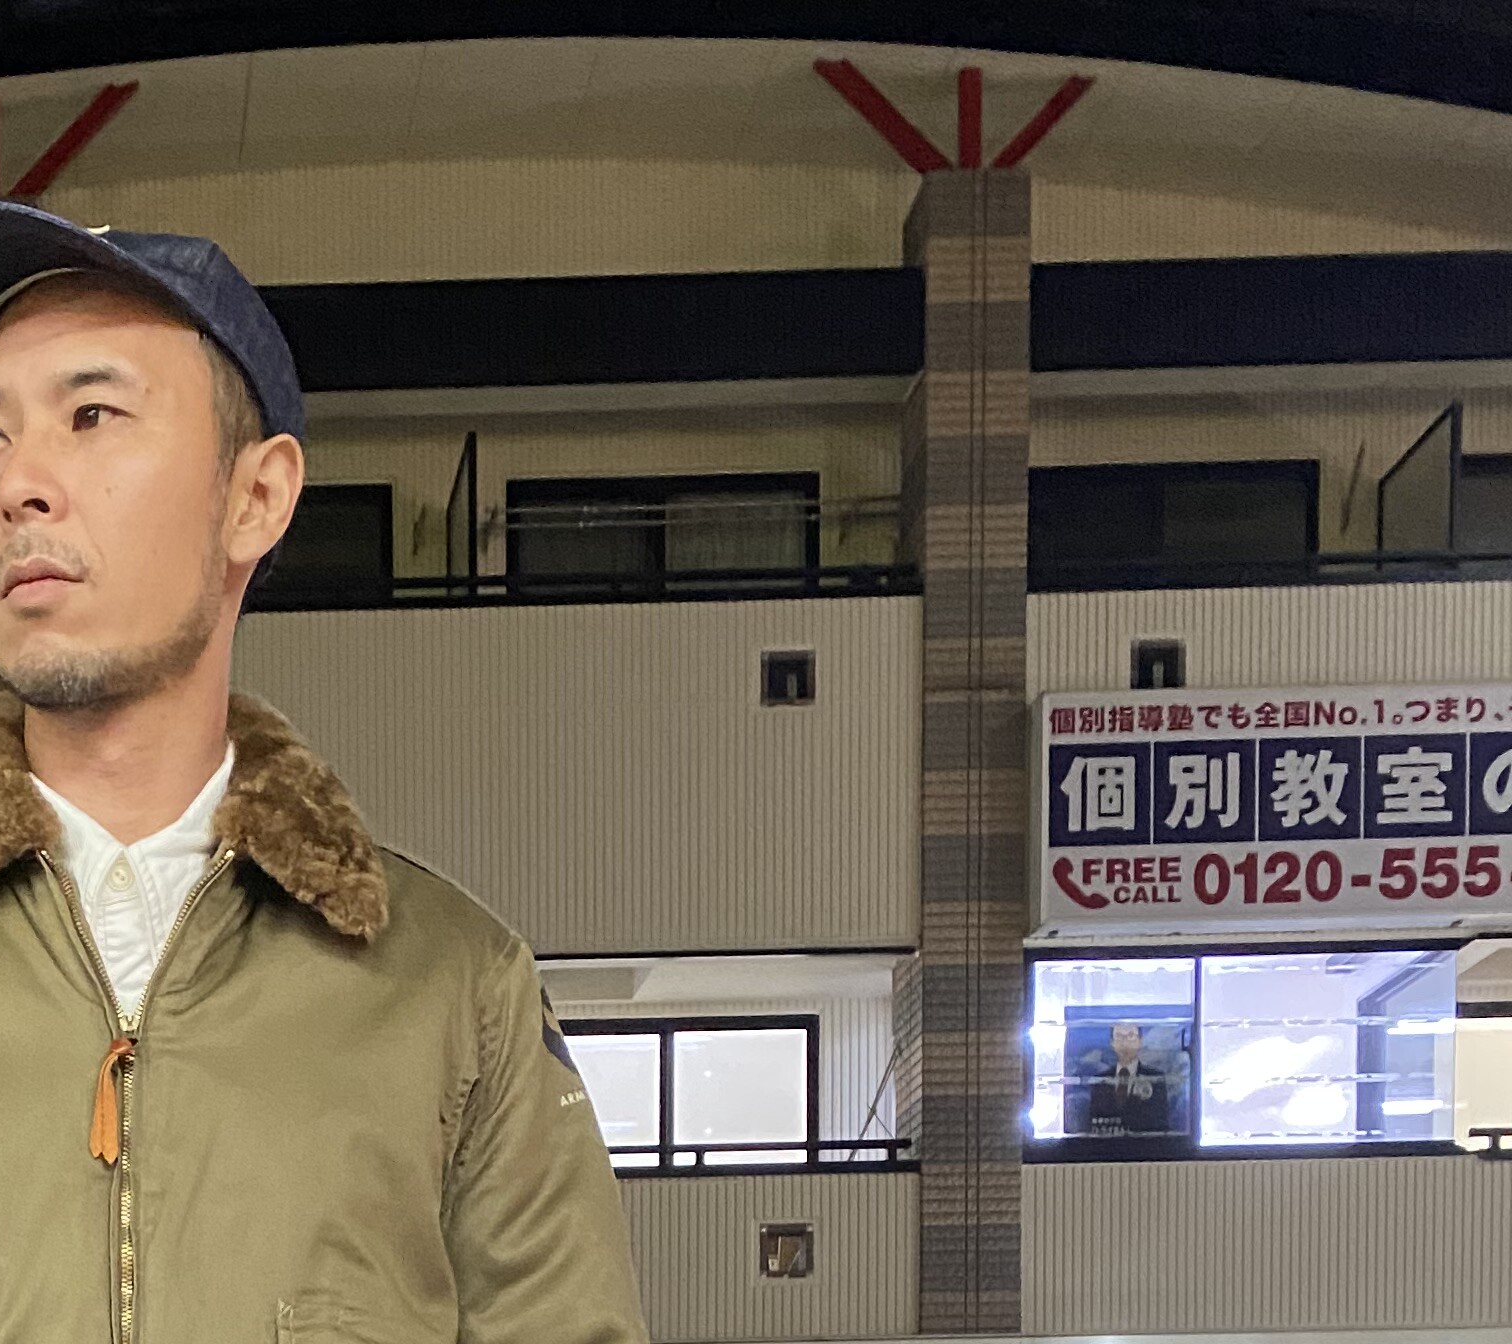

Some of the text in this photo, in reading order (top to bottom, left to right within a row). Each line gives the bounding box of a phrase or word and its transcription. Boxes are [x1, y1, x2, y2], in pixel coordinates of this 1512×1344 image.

[1049, 696, 1512, 735] 個別指導塾でも全国No.1。つまり、
[1082, 856, 1181, 885] FREE
[1193, 846, 1512, 905] 0120-555
[1113, 885, 1181, 904] CALL
